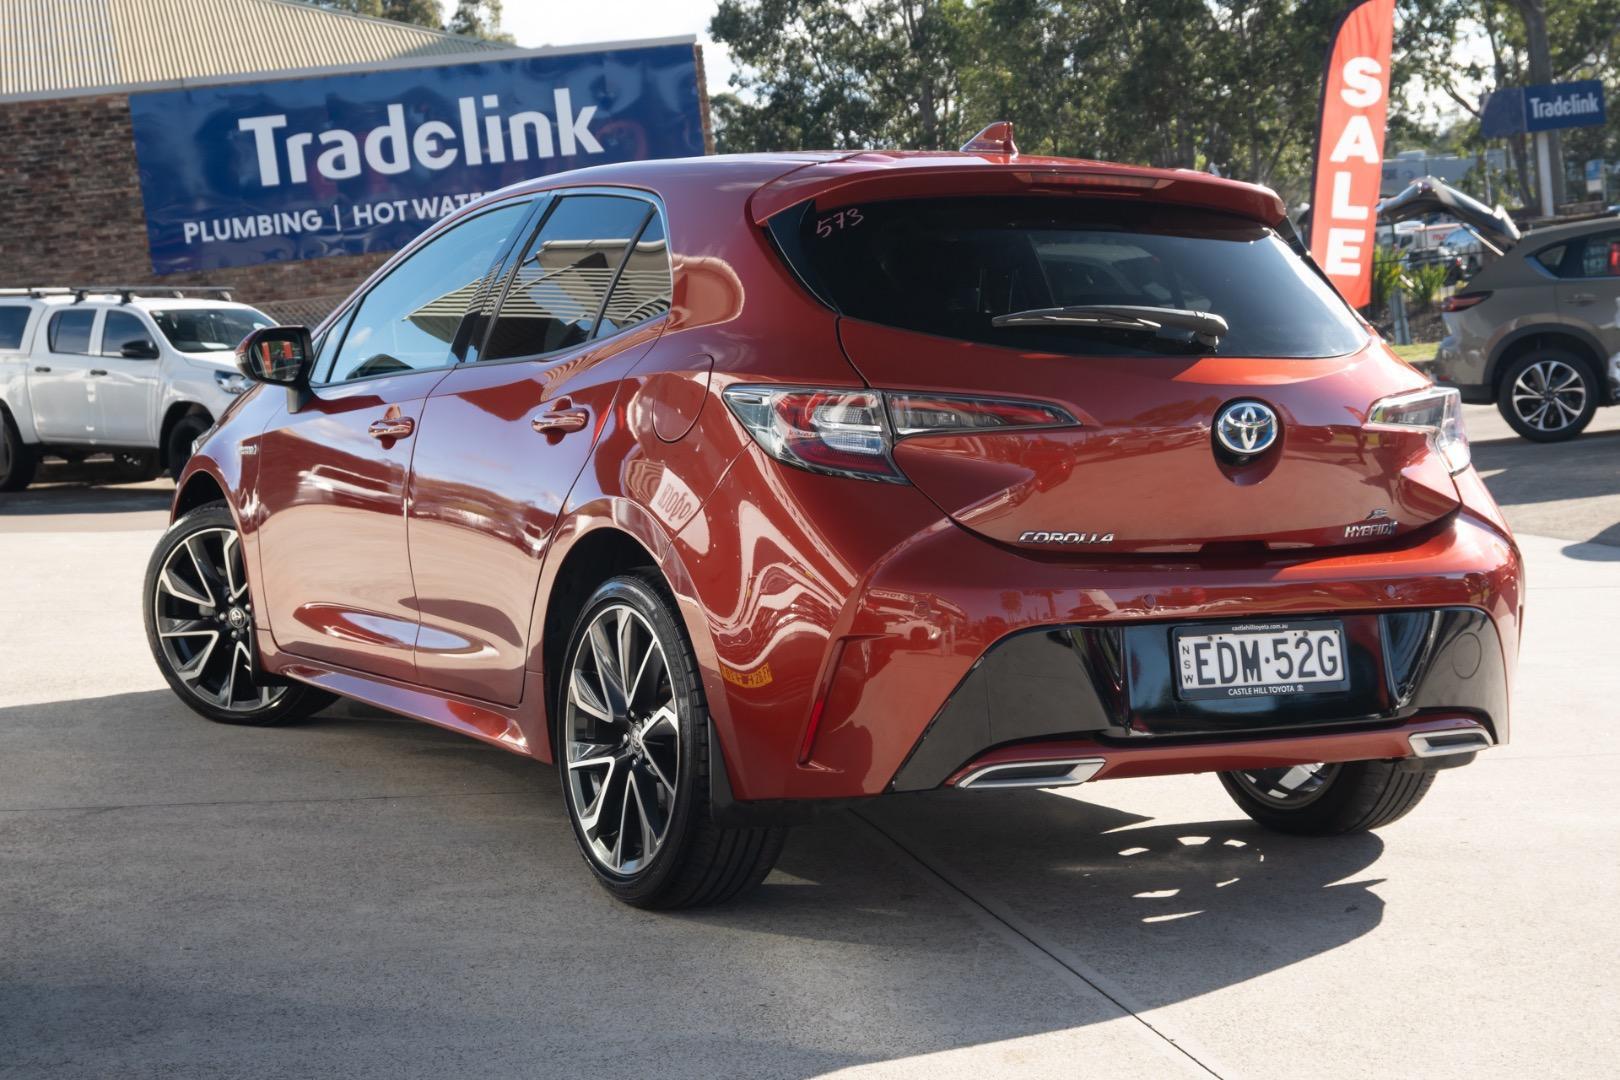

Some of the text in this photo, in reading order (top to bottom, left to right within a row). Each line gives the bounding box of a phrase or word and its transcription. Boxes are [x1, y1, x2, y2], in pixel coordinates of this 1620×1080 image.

[1529, 92, 1600, 119] Tradelink
[237, 87, 605, 187] Tradelink
[1325, 56, 1383, 276] SALE
[183, 204, 323, 244] PLUMBING
[354, 200, 408, 227] HOT
[816, 208, 864, 238] 573
[1017, 532, 1115, 544] COROLLA
[1182, 645, 1194, 684] NSW
[1228, 685, 1295, 696] CASTLE HILL TOYOTA
